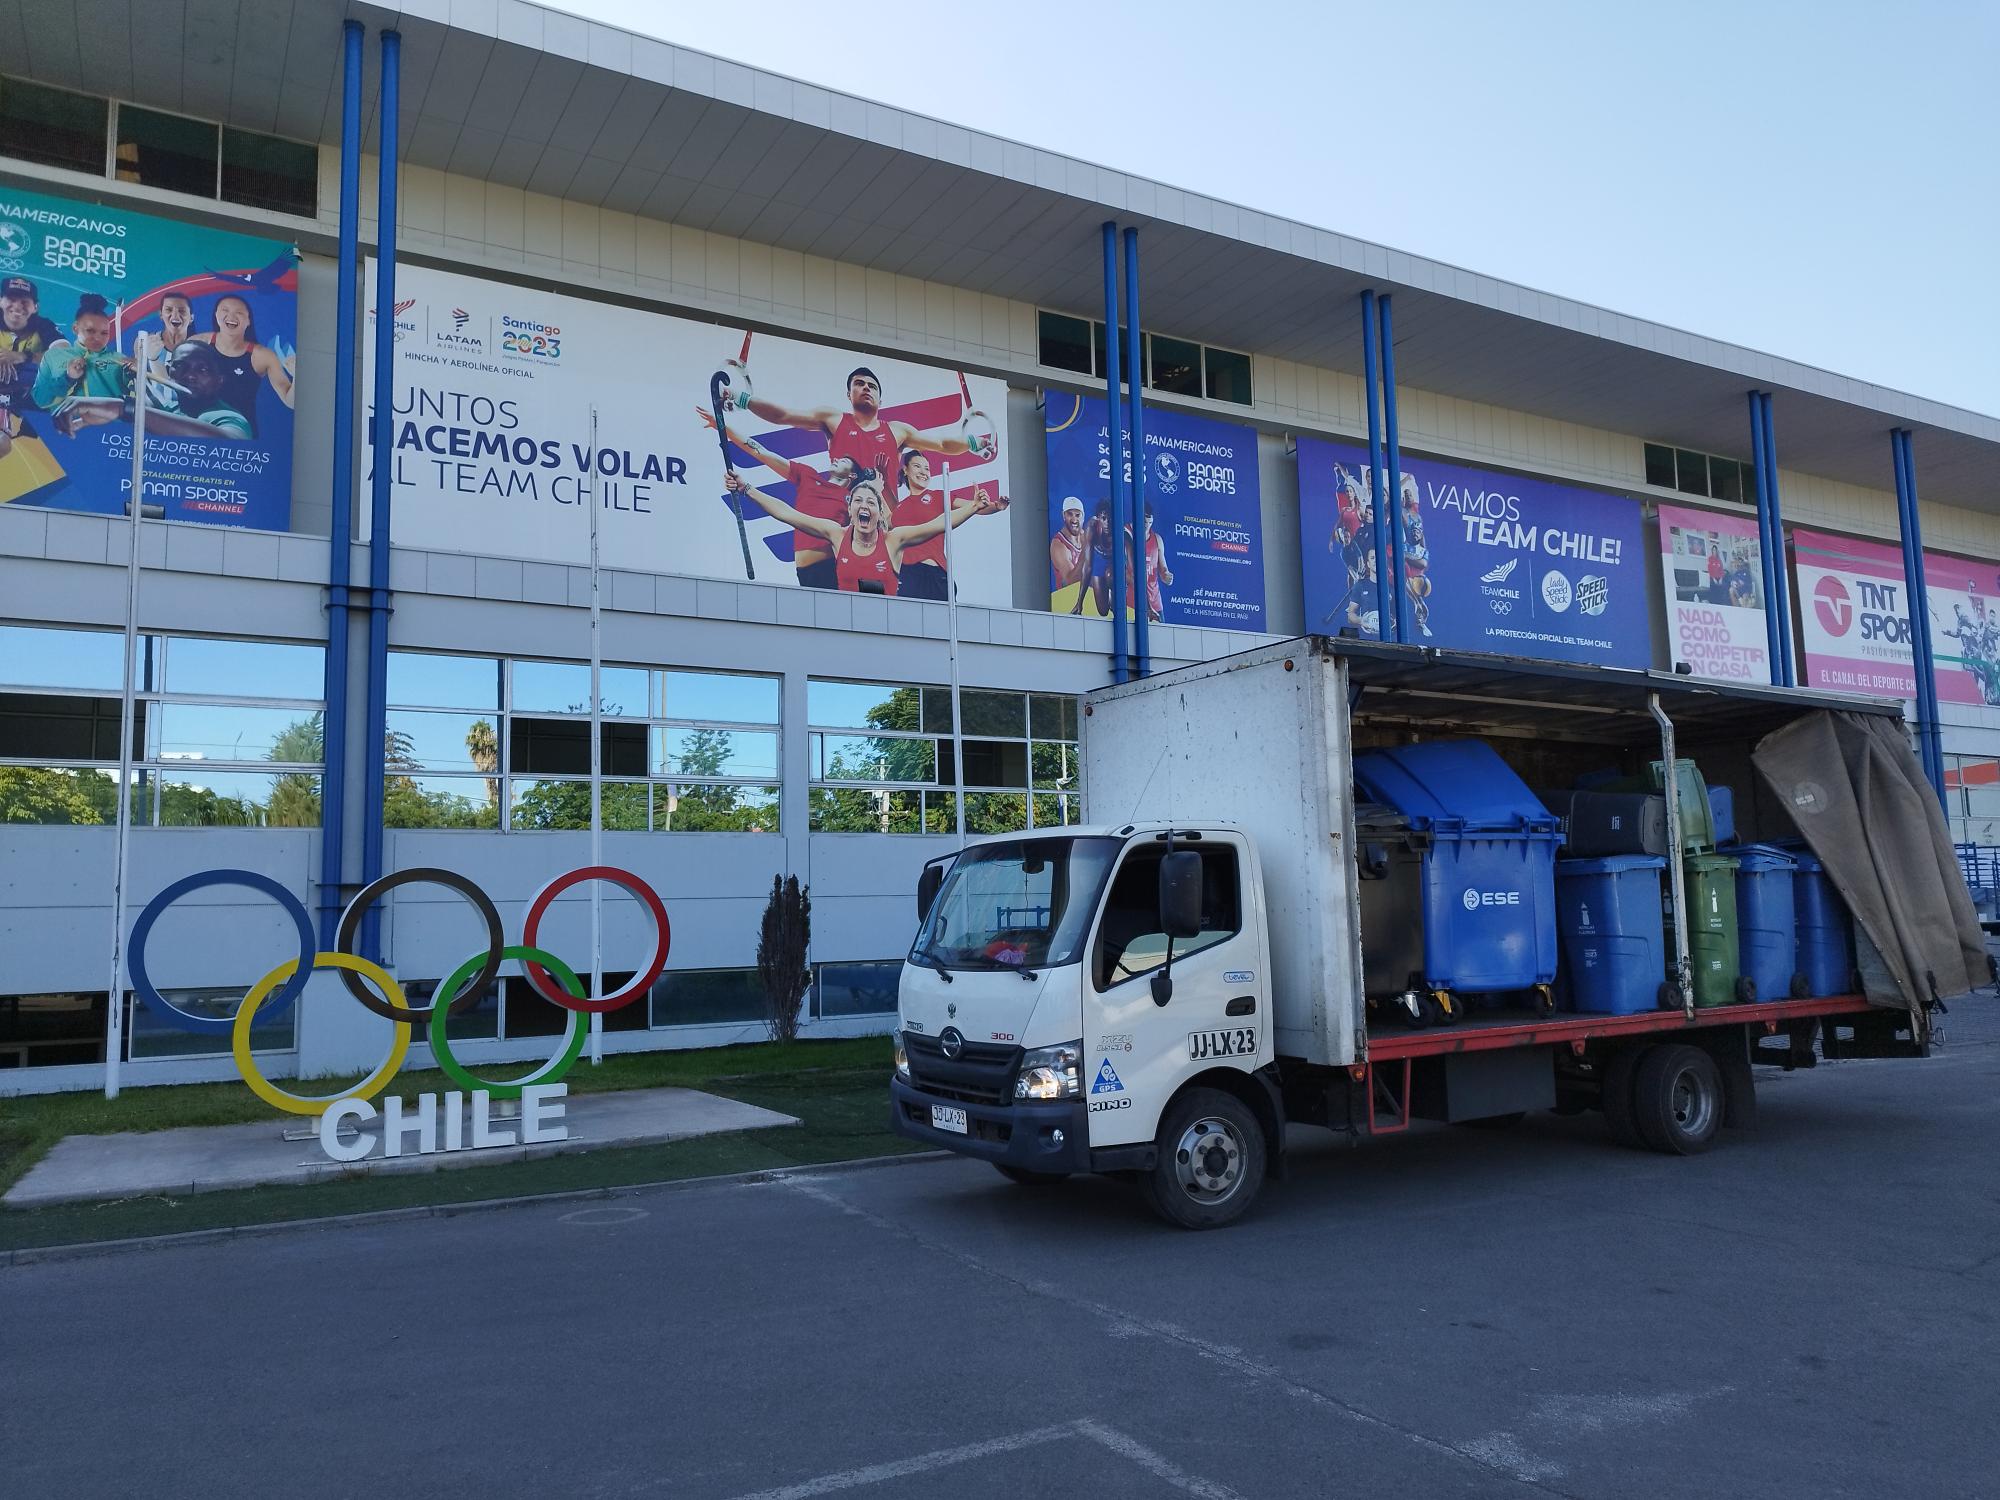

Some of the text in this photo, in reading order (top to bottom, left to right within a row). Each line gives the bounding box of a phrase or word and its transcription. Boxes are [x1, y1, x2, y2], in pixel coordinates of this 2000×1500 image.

[44, 235, 126, 264] PANAM
[43, 251, 127, 279] SPORTS
[502, 315, 561, 336] Santiago
[436, 343, 482, 355] AIRLINES
[437, 333, 482, 347] LATAM
[502, 331, 561, 359] 2023
[405, 352, 439, 364] HINCHA
[450, 359, 499, 373] AEROLÍNEA
[501, 367, 535, 379] OFICIAL
[368, 387, 519, 429] UNTOS
[101, 433, 132, 447] LOS
[208, 447, 271, 463] ATLETAS
[1146, 434, 1233, 458] PANAMERICANOS
[108, 448, 133, 460] DEL
[192, 458, 210, 469] EN
[211, 460, 263, 475] ACCIÓN
[572, 444, 688, 485] VOLAR
[1188, 462, 1235, 481] PANAM
[140, 471, 236, 487] OTALMENTE GRATIS EN
[431, 459, 538, 500] TEAM
[551, 476, 652, 513] CHILE
[1188, 476, 1236, 495] SPORTS
[120, 478, 248, 505] PNAM SPORTS
[1426, 481, 1521, 521] VAMOS
[197, 502, 243, 514] CHANNEL
[1183, 516, 1216, 525] TOTALMENTE
[1217, 520, 1235, 528] GRATIS
[1175, 524, 1251, 544] PANAM SPORTS
[1462, 514, 1622, 565] TEAM CHILE!
[1221, 543, 1248, 552] CHANNEL
[1204, 590, 1225, 599] PARTE
[1226, 592, 1238, 600] DEL
[1480, 585, 1520, 599] TEAMCHILE
[1545, 583, 1568, 597] Speed
[1576, 577, 1607, 600] SPEED
[1856, 580, 1897, 612] TNT
[1170, 596, 1260, 612] MAYOR EVENTO DEPORTIVO
[1549, 593, 1568, 605] Stick
[1581, 591, 1608, 612] STICK
[1199, 609, 1222, 618] HISTORIA
[1677, 608, 1726, 627] NADA
[1485, 627, 1613, 648] LA PROTECCIÓN OFICIAL DEL TEAM CHILE
[1680, 625, 1731, 643] COMO
[1860, 612, 1912, 644] SPOR
[1681, 642, 1765, 663] COMPETIR
[1708, 661, 1752, 678] CASA
[1821, 669, 1831, 683] EL
[1832, 671, 1857, 686] CANAL
[1857, 674, 1872, 687] DEL
[1873, 675, 1904, 690] DEPORTE
[1482, 891, 1520, 905] ESE
[991, 1032, 1014, 1040] 300
[1099, 1084, 1116, 1092] GPS
[1089, 1098, 1132, 1112] HINO
[320, 1083, 568, 1162] CHILE
